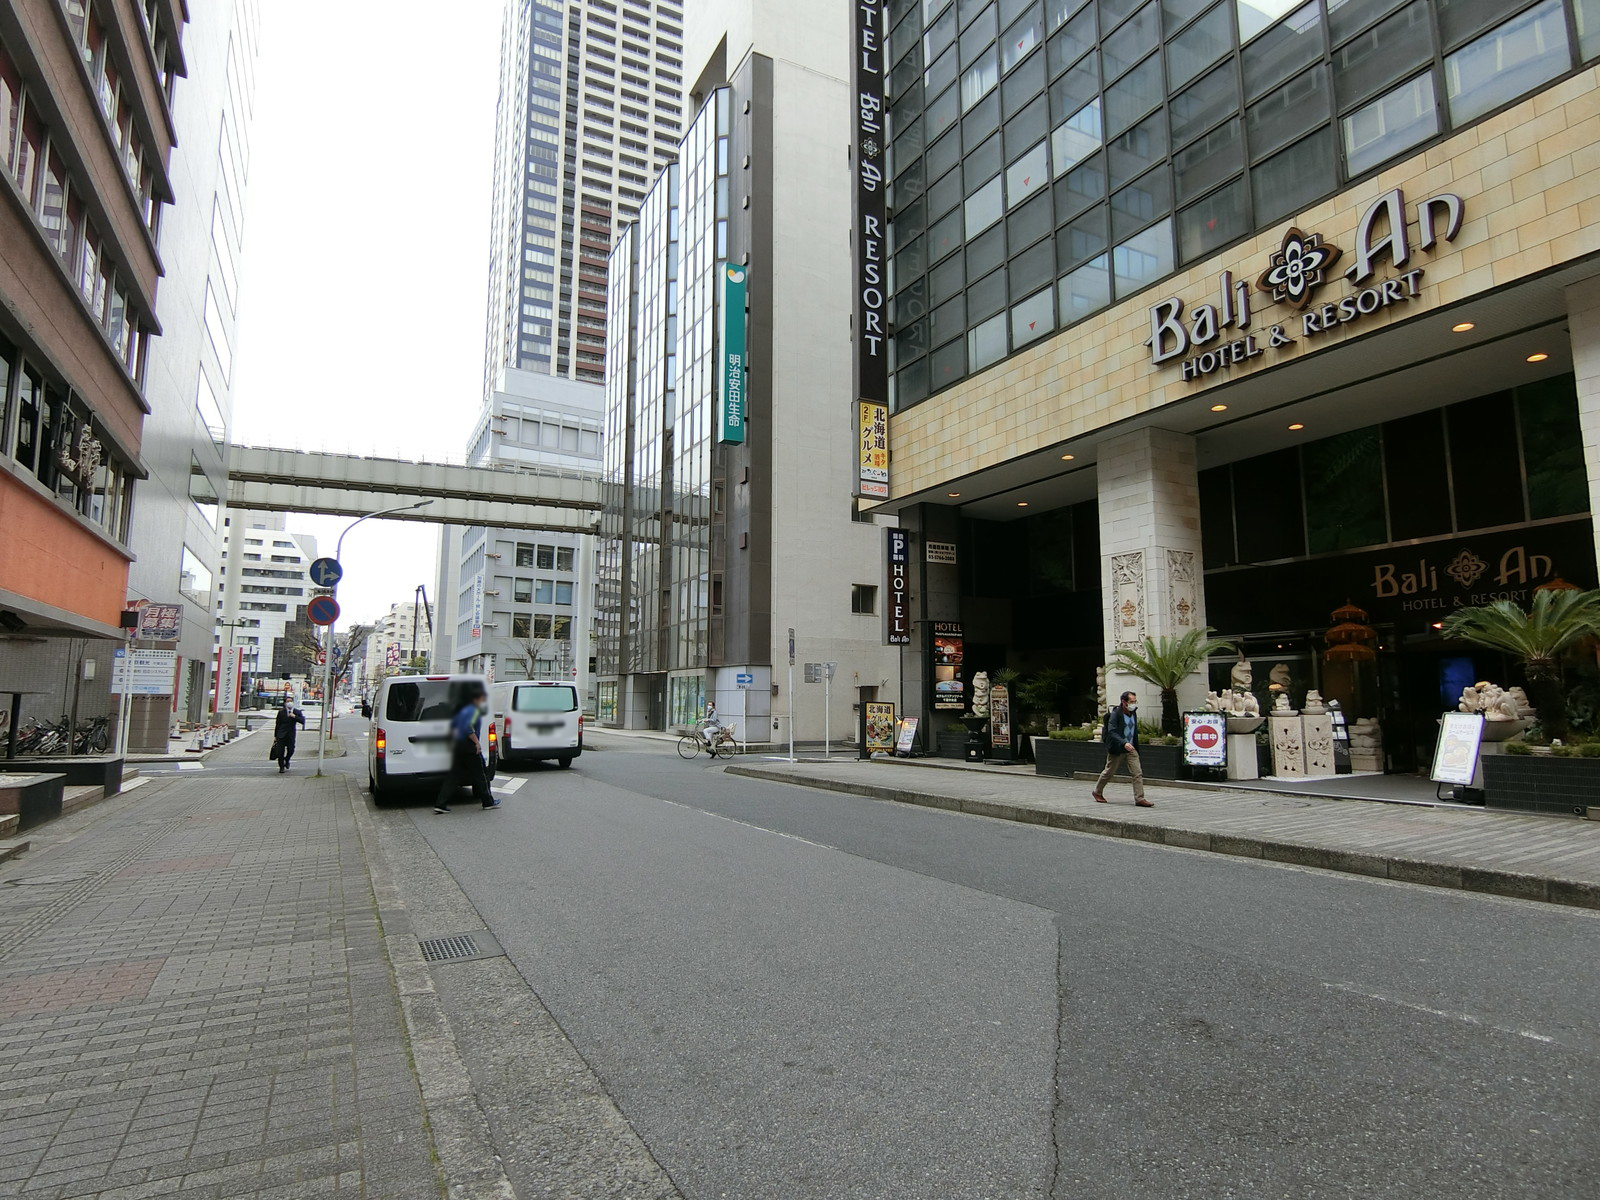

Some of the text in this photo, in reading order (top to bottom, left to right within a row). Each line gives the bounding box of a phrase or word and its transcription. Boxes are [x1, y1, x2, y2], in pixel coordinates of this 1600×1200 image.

[859, 92, 881, 134] Bali
[864, 214, 883, 356] RESORT
[1144, 188, 1465, 366] Bali An
[1181, 269, 1425, 382] HOTEL & RESORT
[729, 354, 741, 427] 明治安田生命
[864, 406, 869, 420] 2F
[874, 408, 885, 450] 北海道
[862, 426, 873, 464] グルメ
[893, 540, 904, 553] P
[1371, 546, 1553, 598] Bali An
[145, 607, 177, 618] 月極
[893, 564, 904, 632] HOTEL
[1402, 589, 1529, 612] HOTEL & RESORT
[934, 622, 962, 632] HOTEL
[869, 704, 891, 714] 北海道
[870, 714, 890, 723] グルメ
[1194, 733, 1217, 741] 営業中
